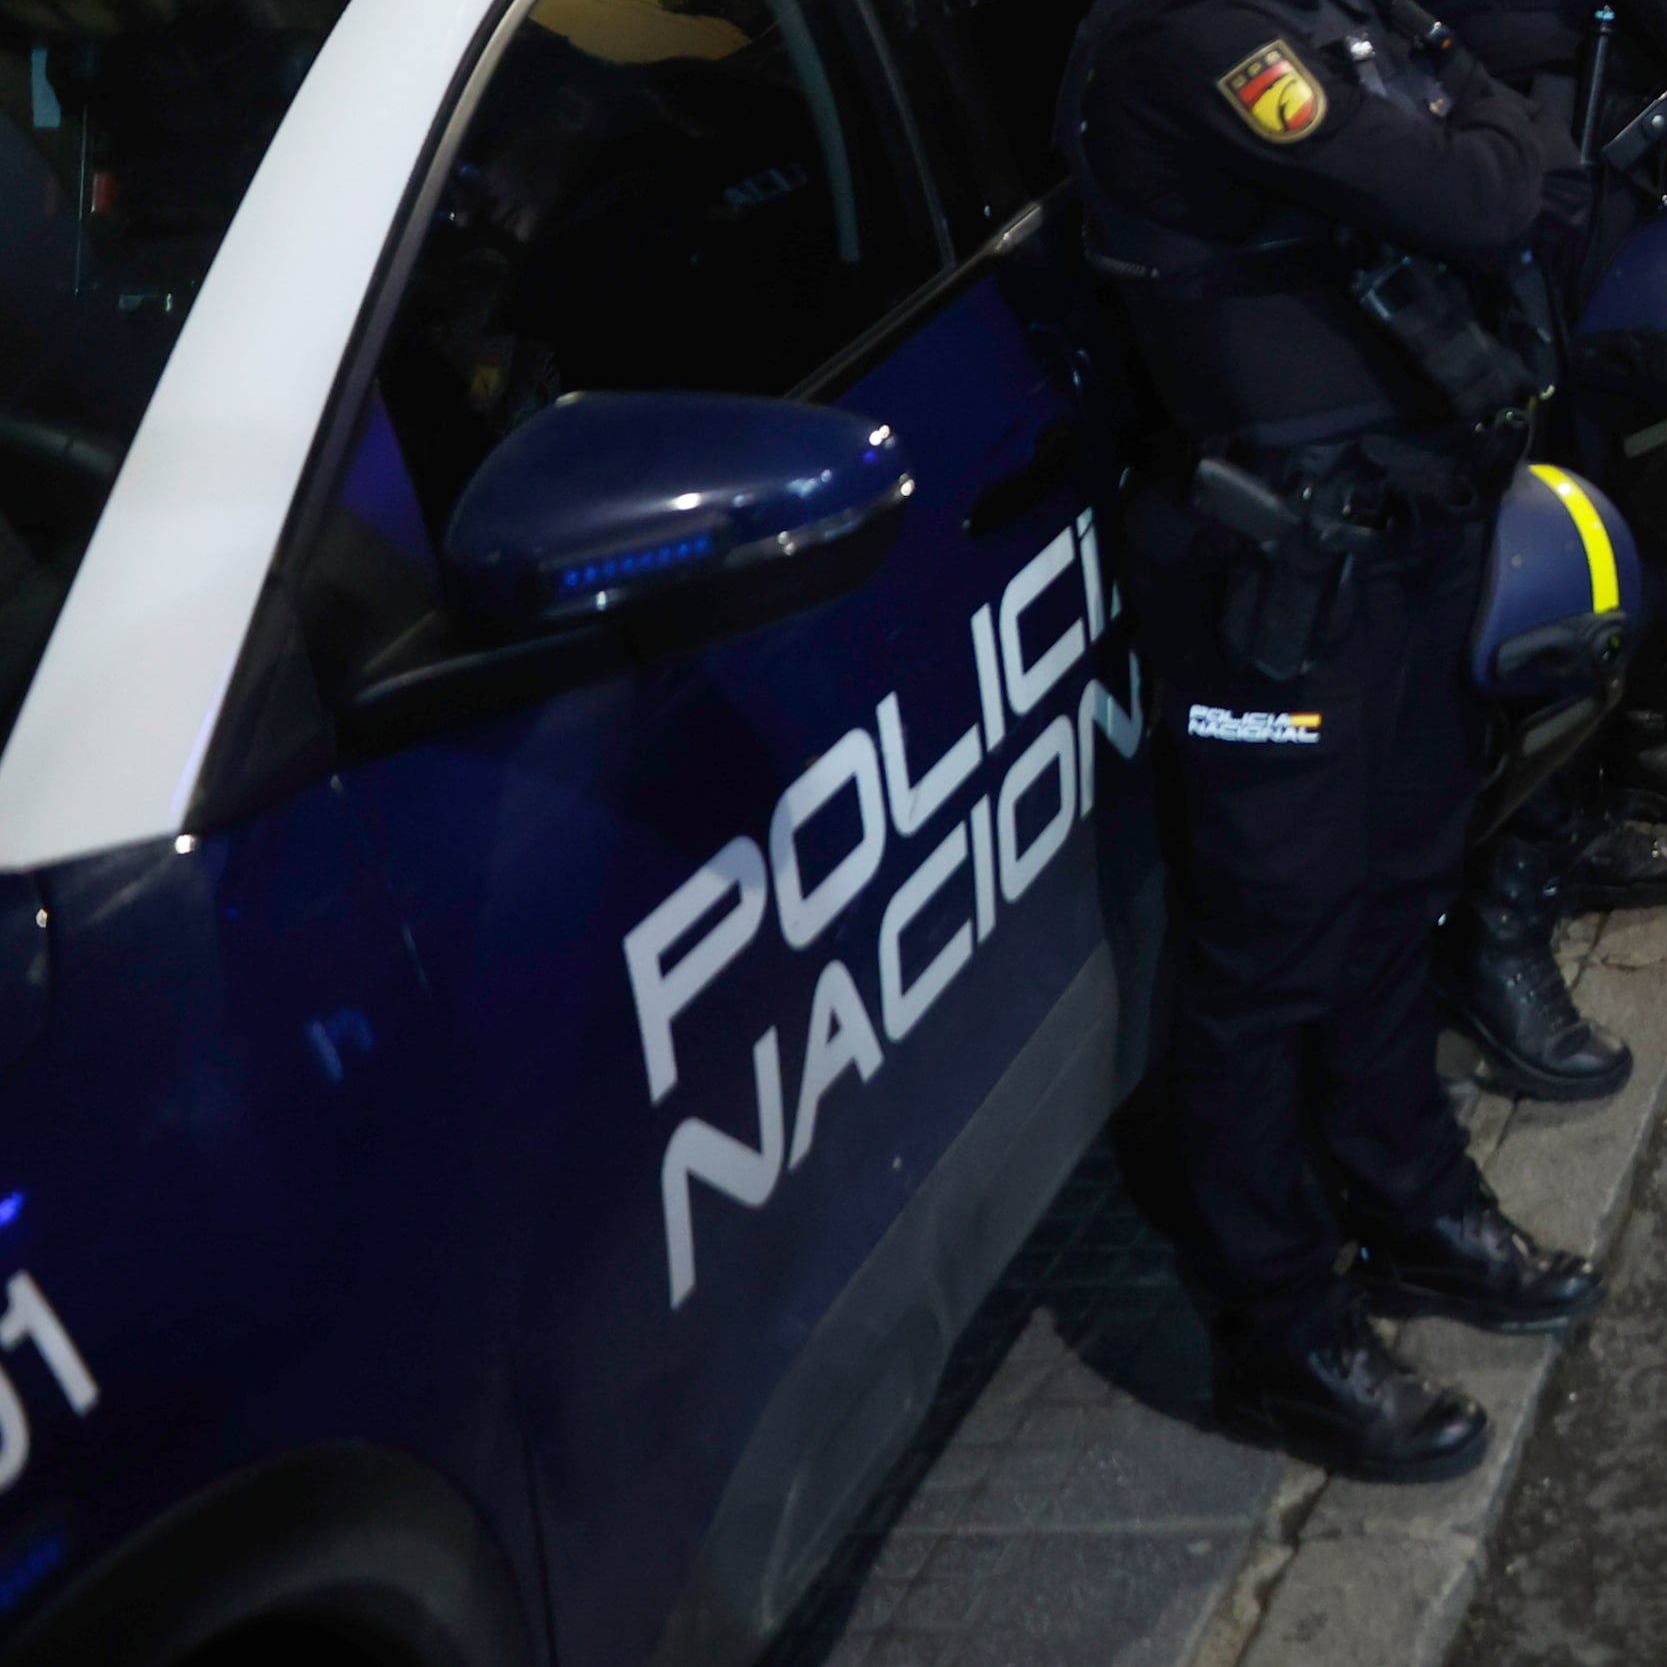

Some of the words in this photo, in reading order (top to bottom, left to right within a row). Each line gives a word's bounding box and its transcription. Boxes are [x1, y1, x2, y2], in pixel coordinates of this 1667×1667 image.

[622, 505, 1123, 1105] POLICI
[1187, 718, 1321, 744] NACIONAL
[1188, 703, 1292, 727] POLICIA
[661, 648, 1144, 1310] NACION
